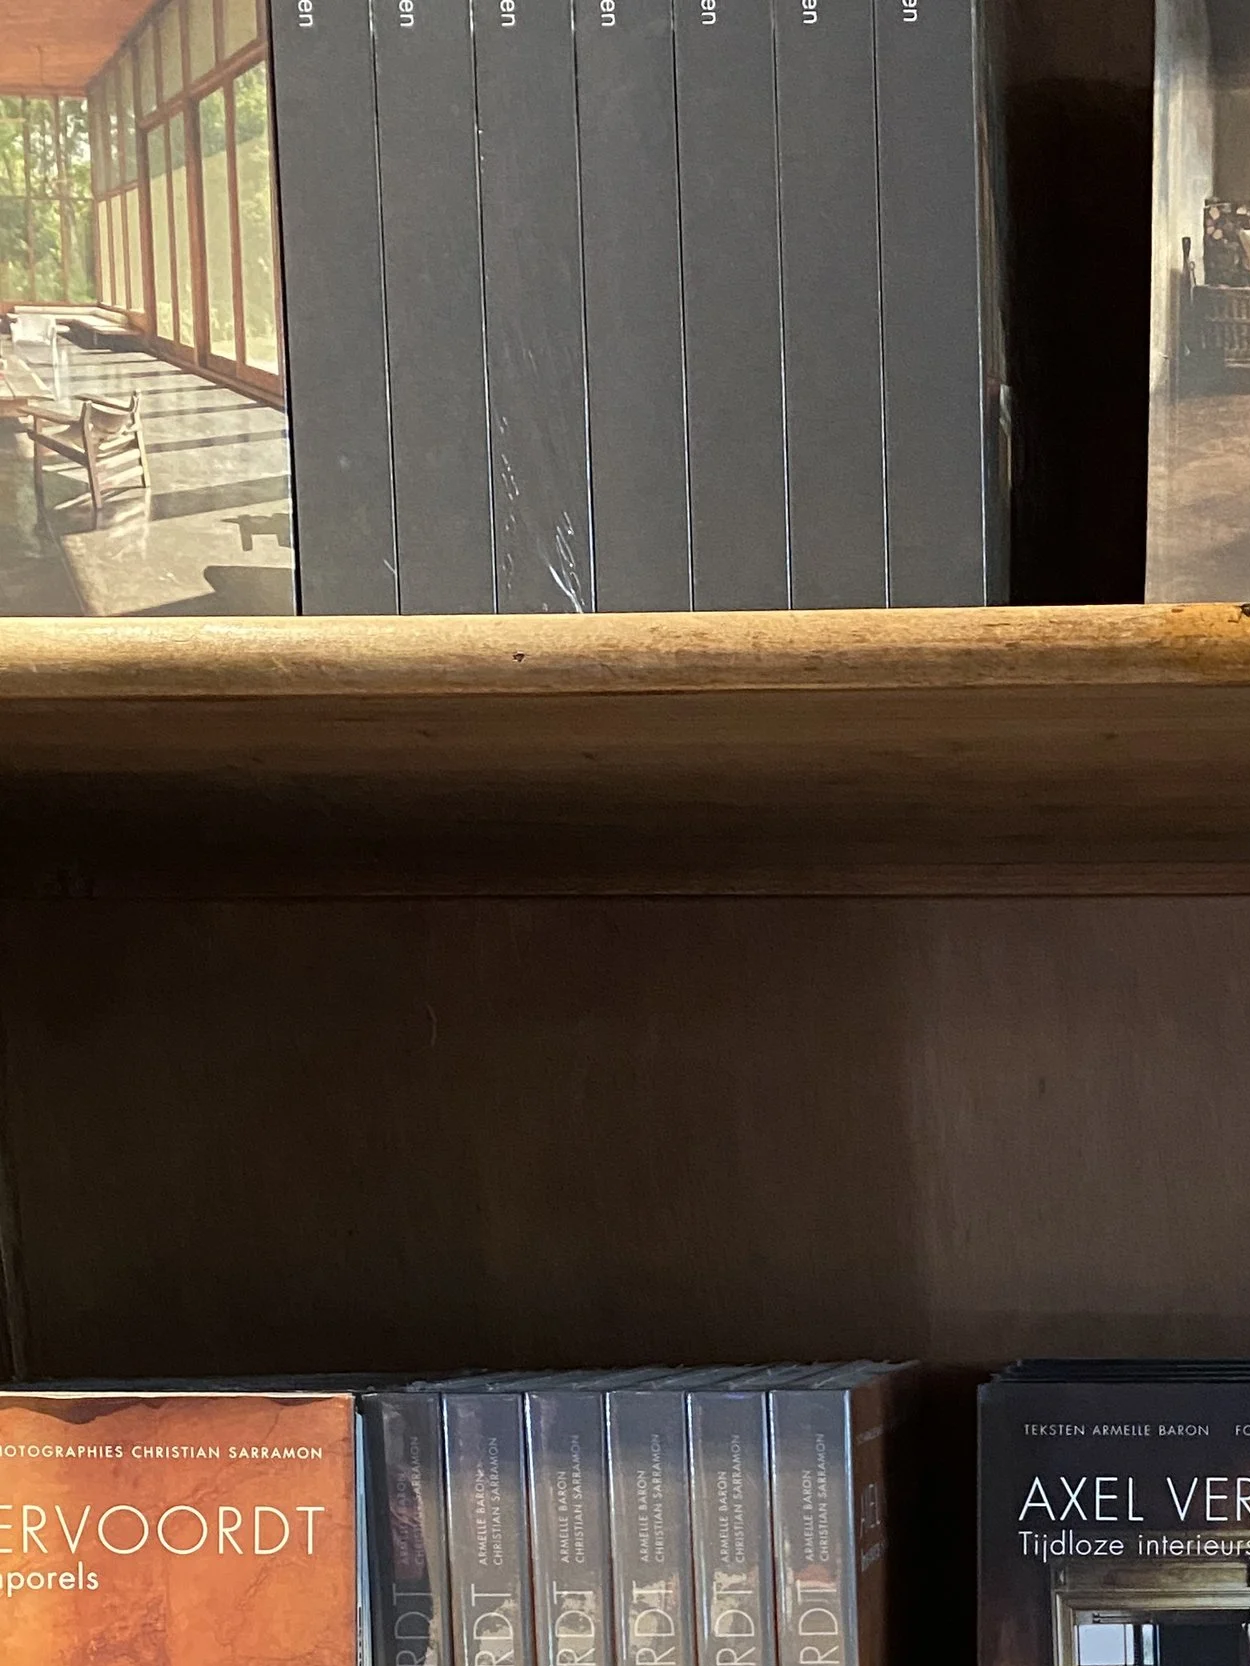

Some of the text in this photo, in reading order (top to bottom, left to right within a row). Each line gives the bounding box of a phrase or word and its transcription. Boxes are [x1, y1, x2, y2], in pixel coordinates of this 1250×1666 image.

[0, 1445, 323, 1460] OTOGRAPHIES CHRISTIAN SARRAMON
[1024, 1423, 1085, 1437] TEKSTEN
[1092, 1423, 1151, 1436] ARMELLE
[1158, 1423, 1210, 1437] BARON
[471, 1474, 489, 1567] ARMELLE BARON
[488, 1436, 504, 1566] CHRISTIAN SARRAMON
[556, 1470, 571, 1564] ARMELLE BARON
[571, 1434, 586, 1564] CHRISTIAN SARRAMON
[636, 1469, 649, 1563] ARMELLE BARON
[651, 1433, 665, 1563] CHRISTIAN SARRAMON
[717, 1470, 730, 1563] ARMELLE BARON
[731, 1434, 746, 1564] CHRISTIAN SARRAMON
[801, 1469, 815, 1562] ARMELLE BARON
[815, 1433, 830, 1562] CHRISTIAN SARRAMON
[1018, 1476, 1144, 1522] AXEL
[0, 1560, 99, 1598] porels
[1018, 1530, 1124, 1562] Tijdloze
